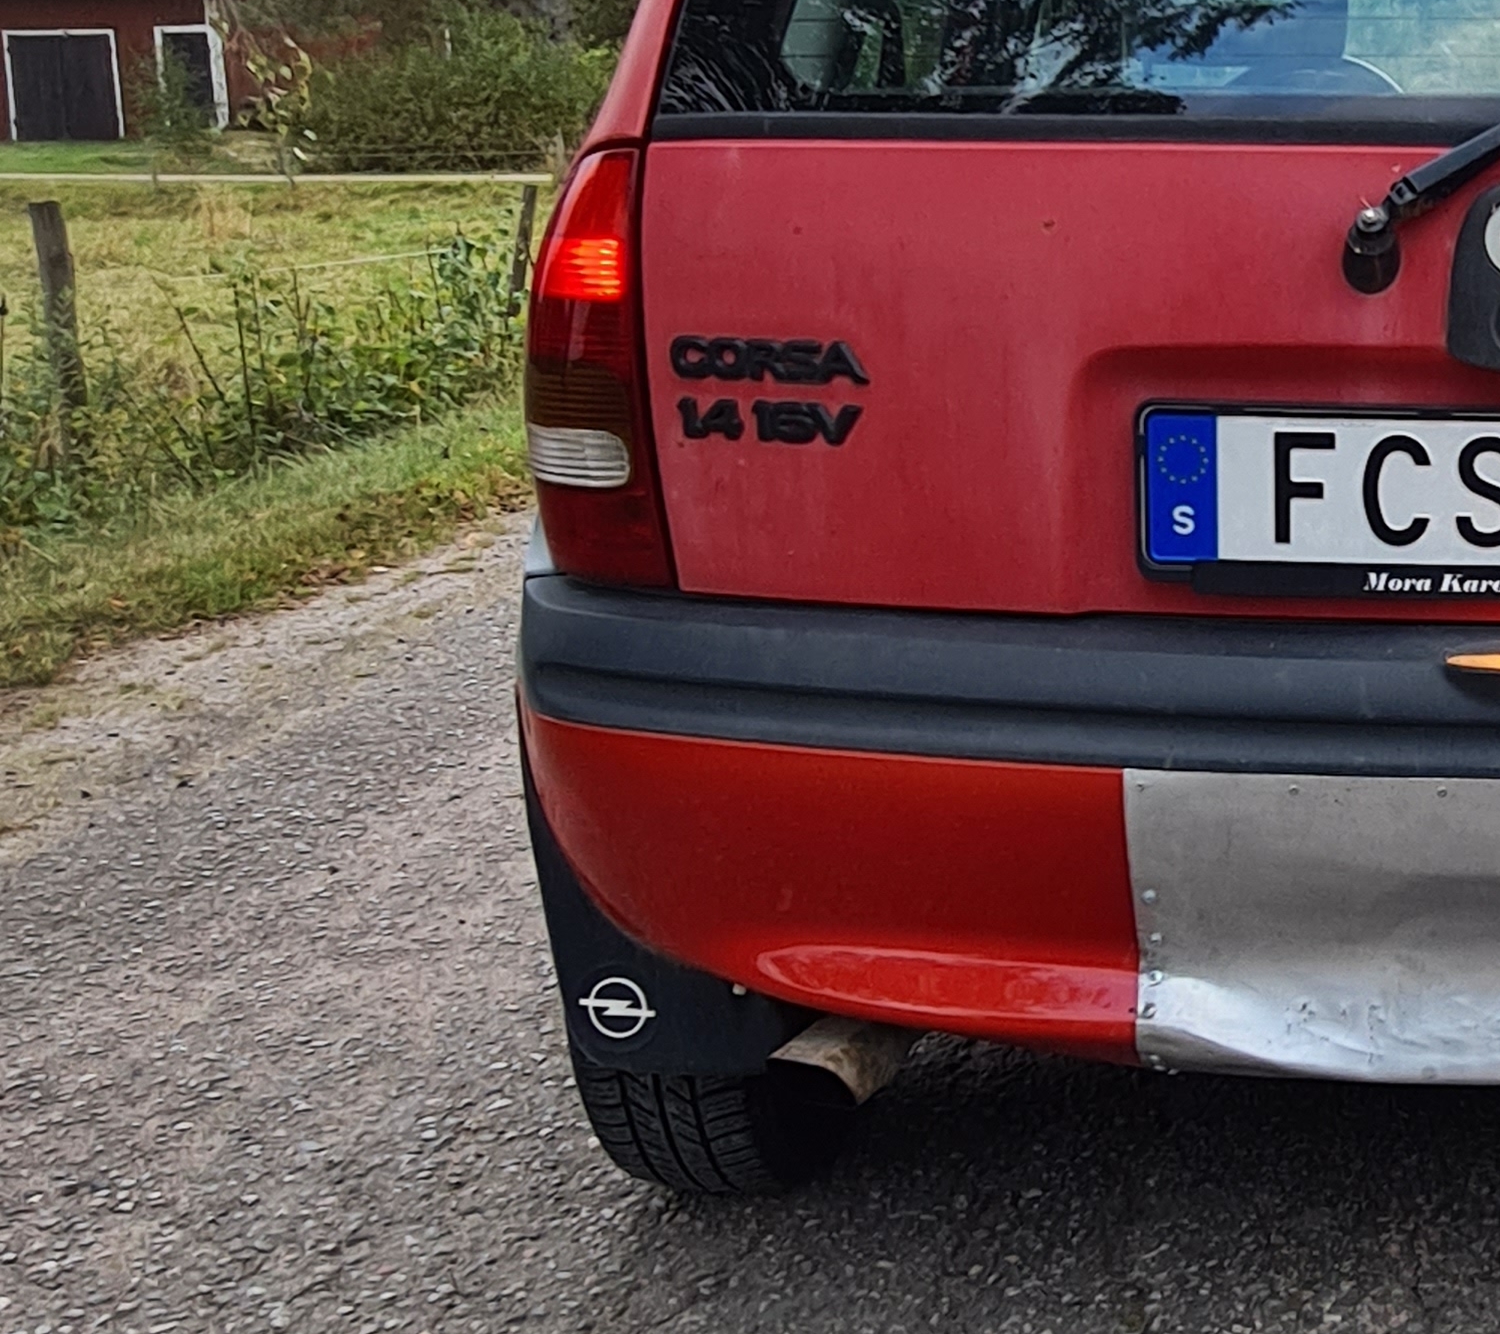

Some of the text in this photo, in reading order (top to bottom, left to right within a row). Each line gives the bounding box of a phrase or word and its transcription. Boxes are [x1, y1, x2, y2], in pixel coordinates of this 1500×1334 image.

[670, 335, 870, 385] CORSA
[751, 398, 864, 446] 16V
[1172, 505, 1195, 535] S
[1363, 571, 1432, 593] Mora
